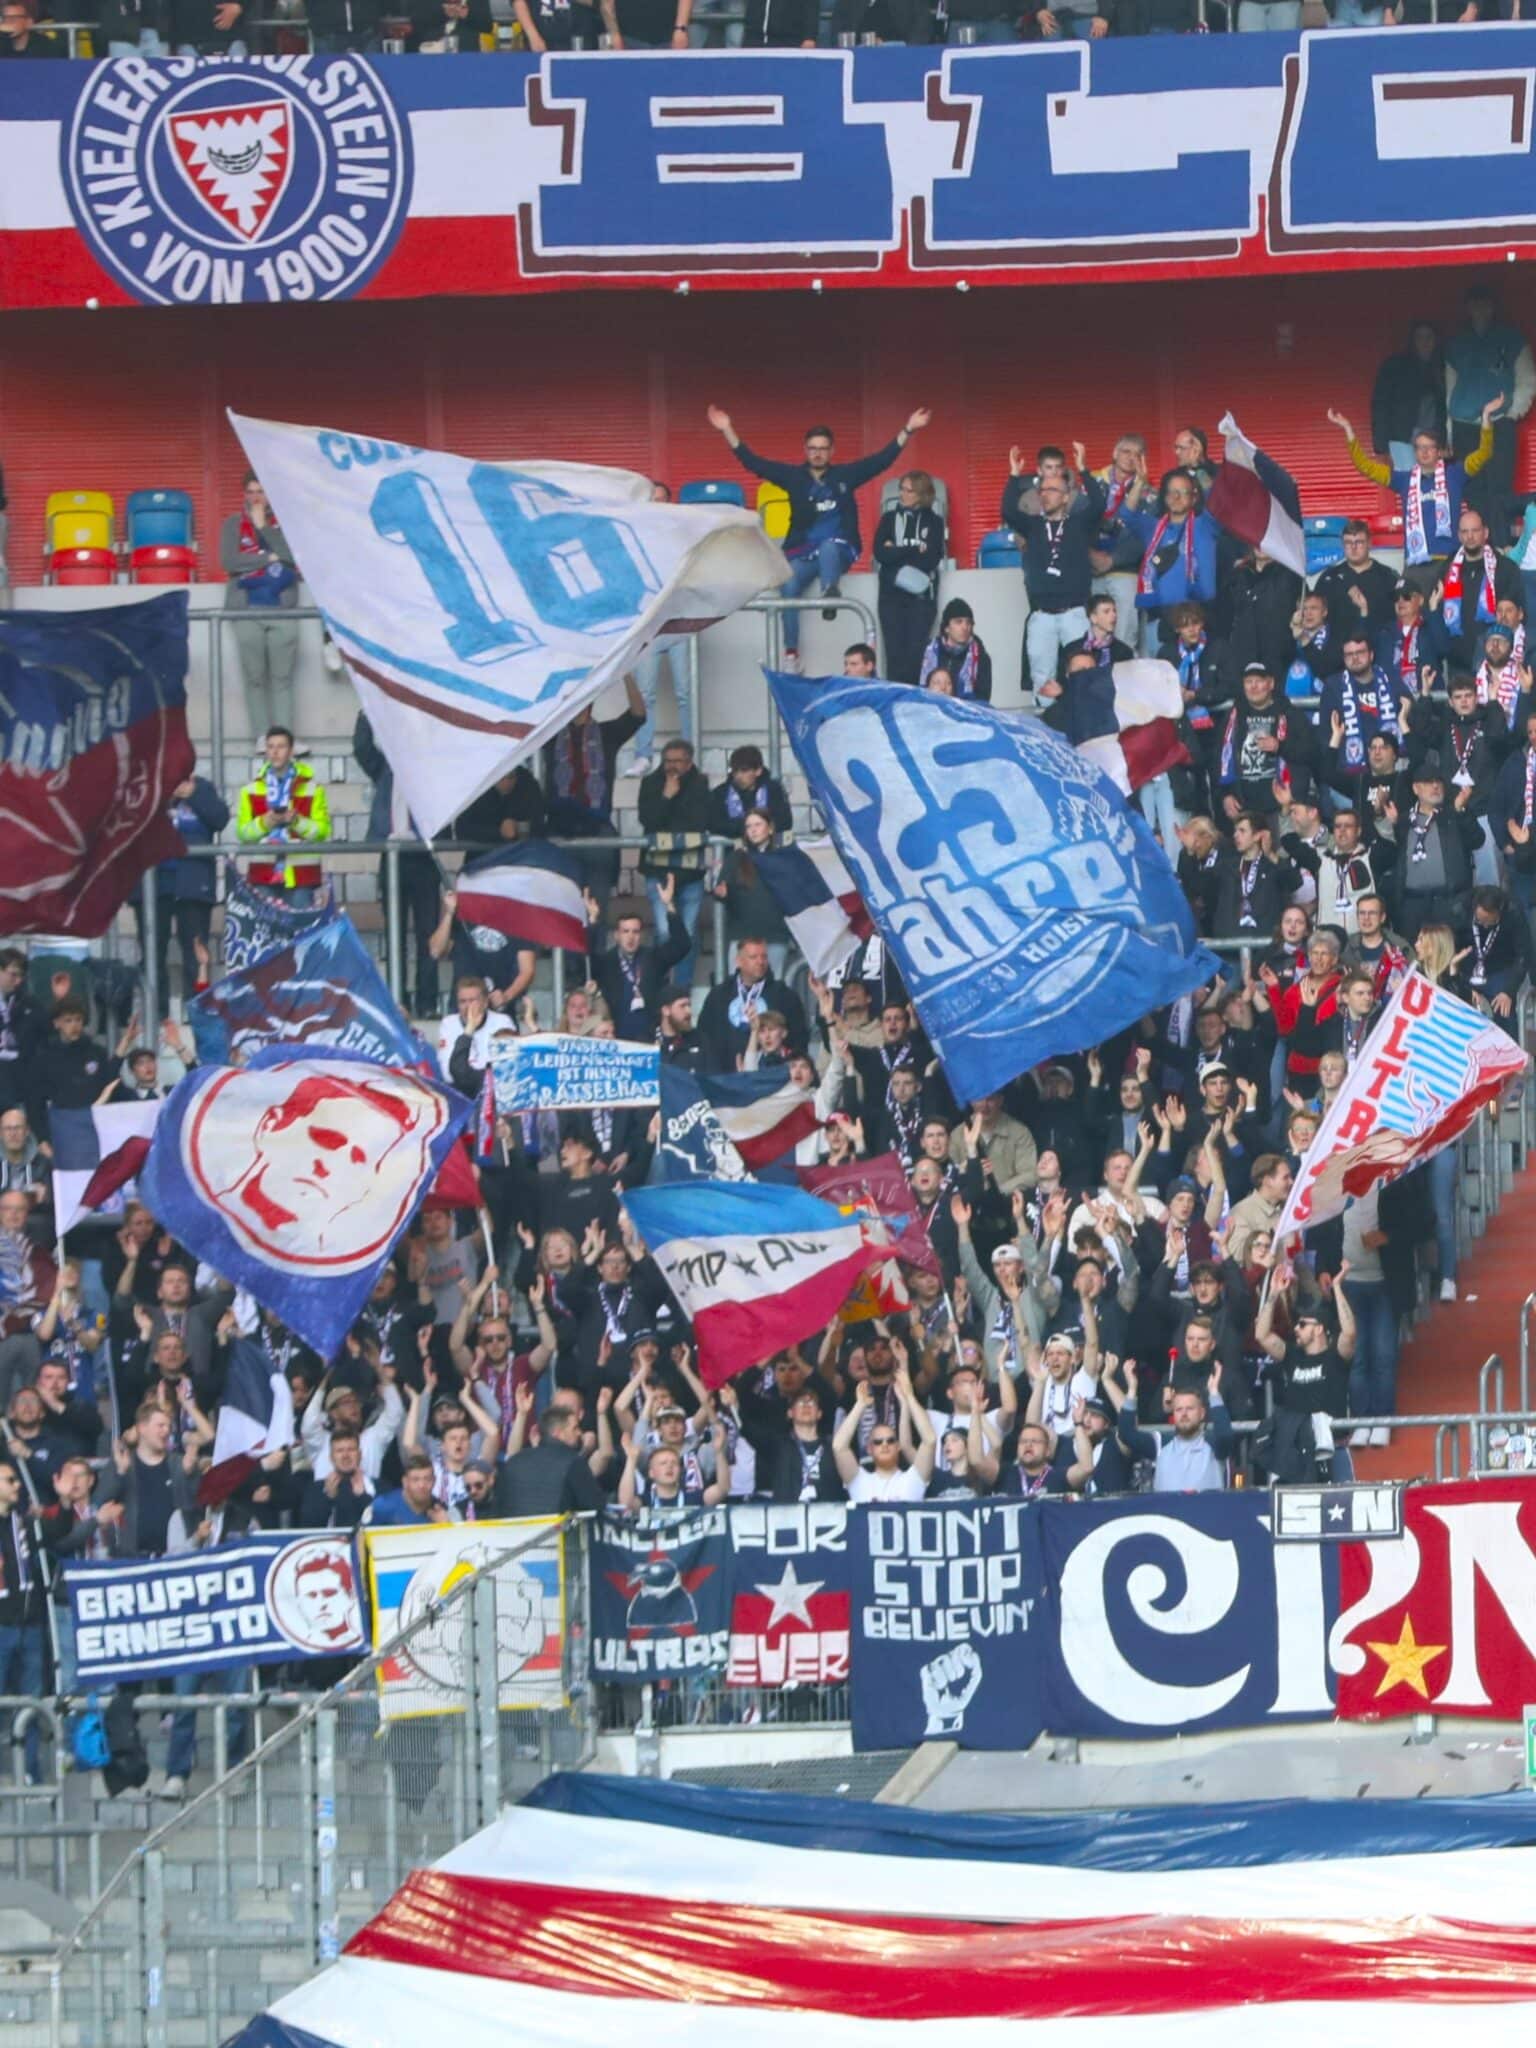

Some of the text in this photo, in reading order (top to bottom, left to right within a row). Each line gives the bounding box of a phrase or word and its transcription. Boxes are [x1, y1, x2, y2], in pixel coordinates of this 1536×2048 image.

[82, 56, 171, 232] KIELER
[144, 214, 369, 304] VON 1900
[369, 463, 664, 667] 16
[815, 700, 1057, 900] 25
[730, 1502, 848, 1555] FOR
[867, 1503, 1029, 1557] DON'T
[76, 1565, 256, 1621] GRUPPO
[874, 1553, 1022, 1606] STOP
[76, 1604, 271, 1661] ERNESTO
[862, 1599, 1036, 1641] BELIEVIN'
[593, 1630, 729, 1673] ULTRAS
[726, 1630, 851, 1684] EVER
